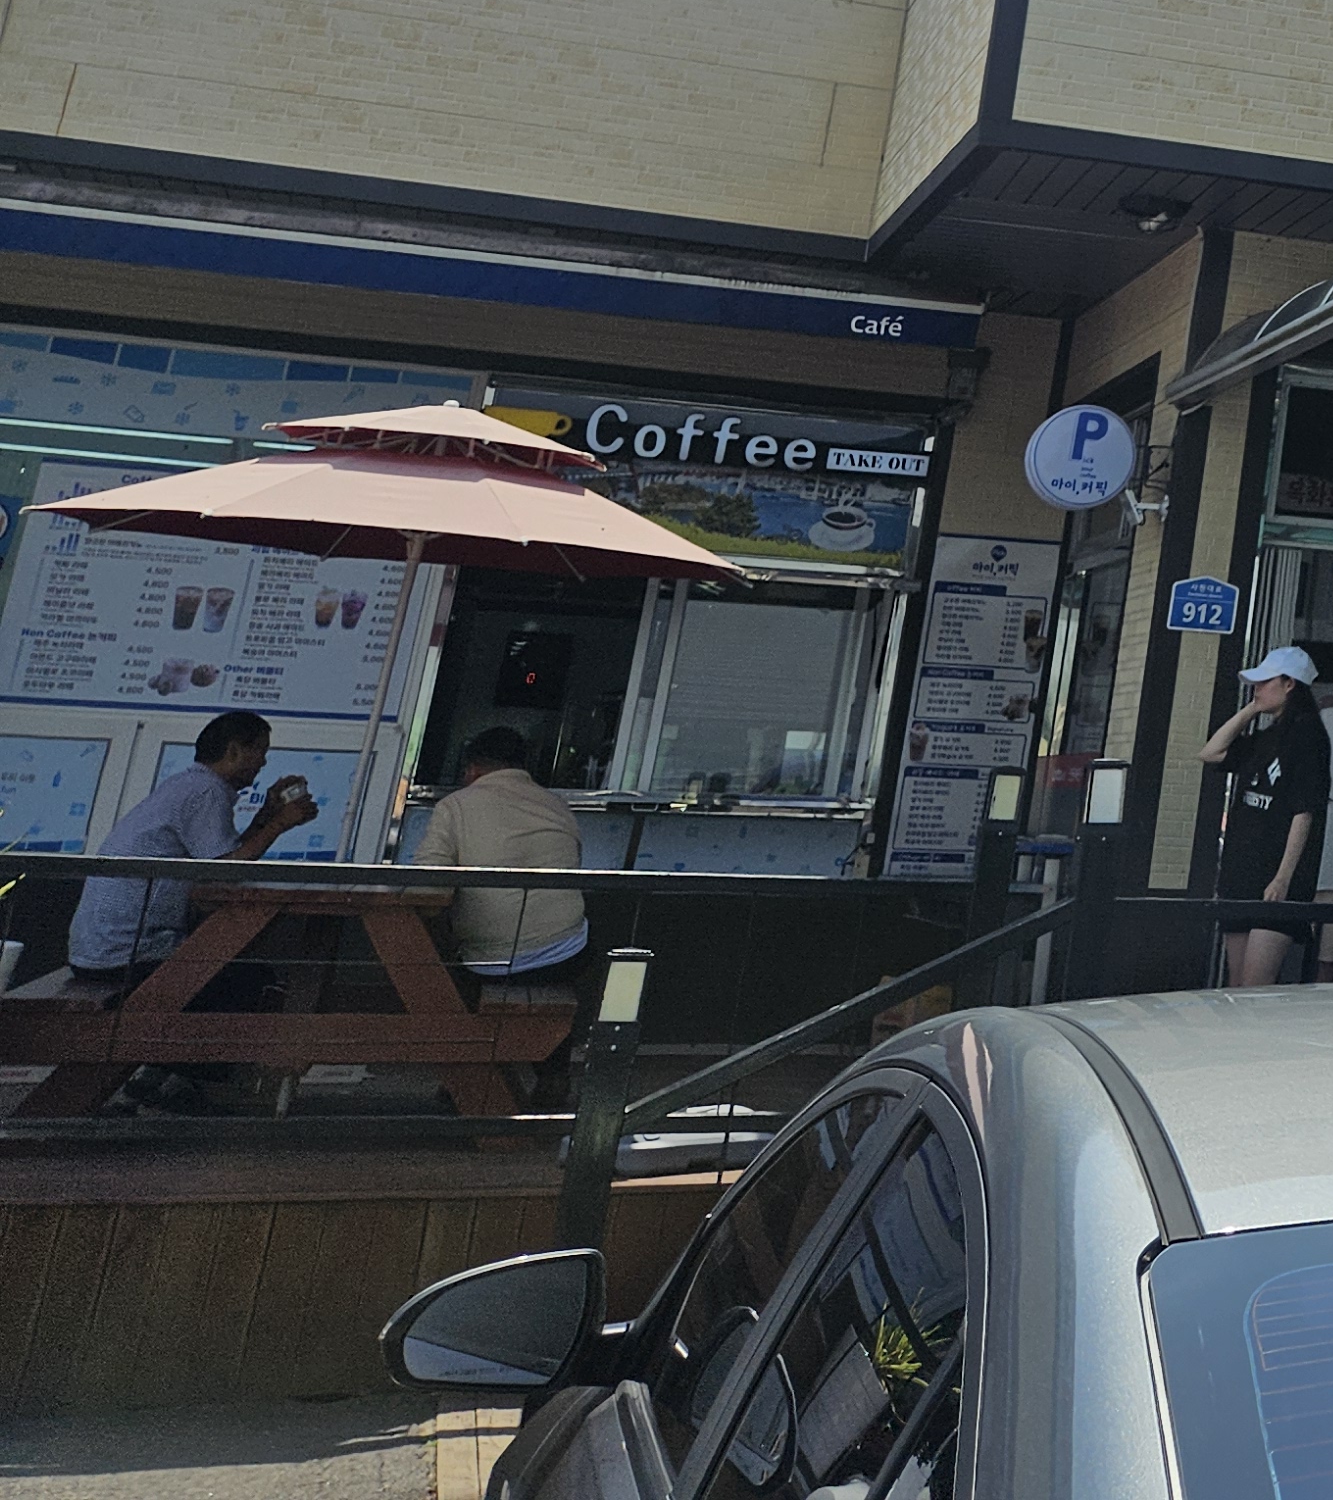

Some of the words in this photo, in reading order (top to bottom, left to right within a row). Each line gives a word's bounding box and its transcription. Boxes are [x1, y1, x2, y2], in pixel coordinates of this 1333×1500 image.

[850, 315, 904, 337] Café
[585, 404, 817, 471] Coffee
[833, 451, 882, 469] TAKE
[889, 456, 926, 472] OUT
[1182, 602, 1223, 625] 912
